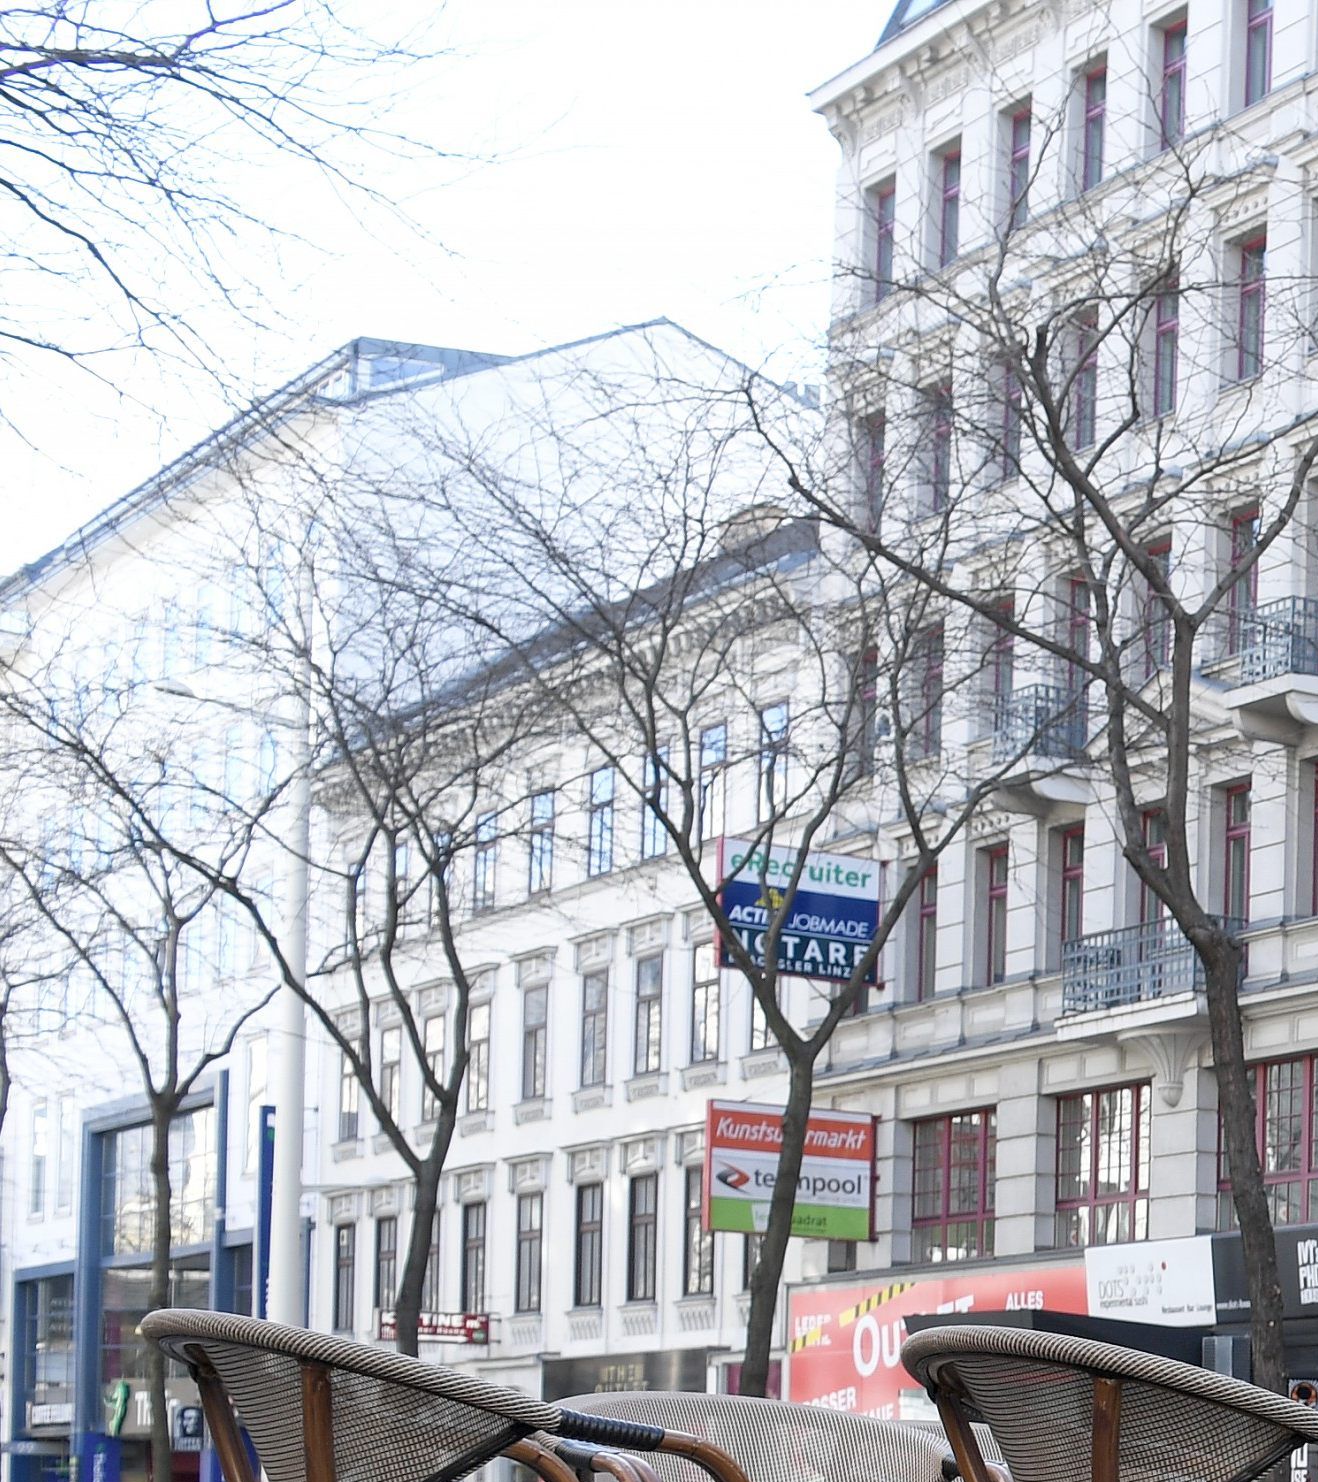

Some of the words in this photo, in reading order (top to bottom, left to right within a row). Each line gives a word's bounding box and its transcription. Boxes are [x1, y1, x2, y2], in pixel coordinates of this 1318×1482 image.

[731, 851, 871, 888] eRecuiter
[788, 913, 869, 937] JOBMADE
[716, 1116, 865, 1149] Kunstsurmarkt
[1005, 1291, 1044, 1311] ALLES
[1098, 1279, 1124, 1299] DOTS
